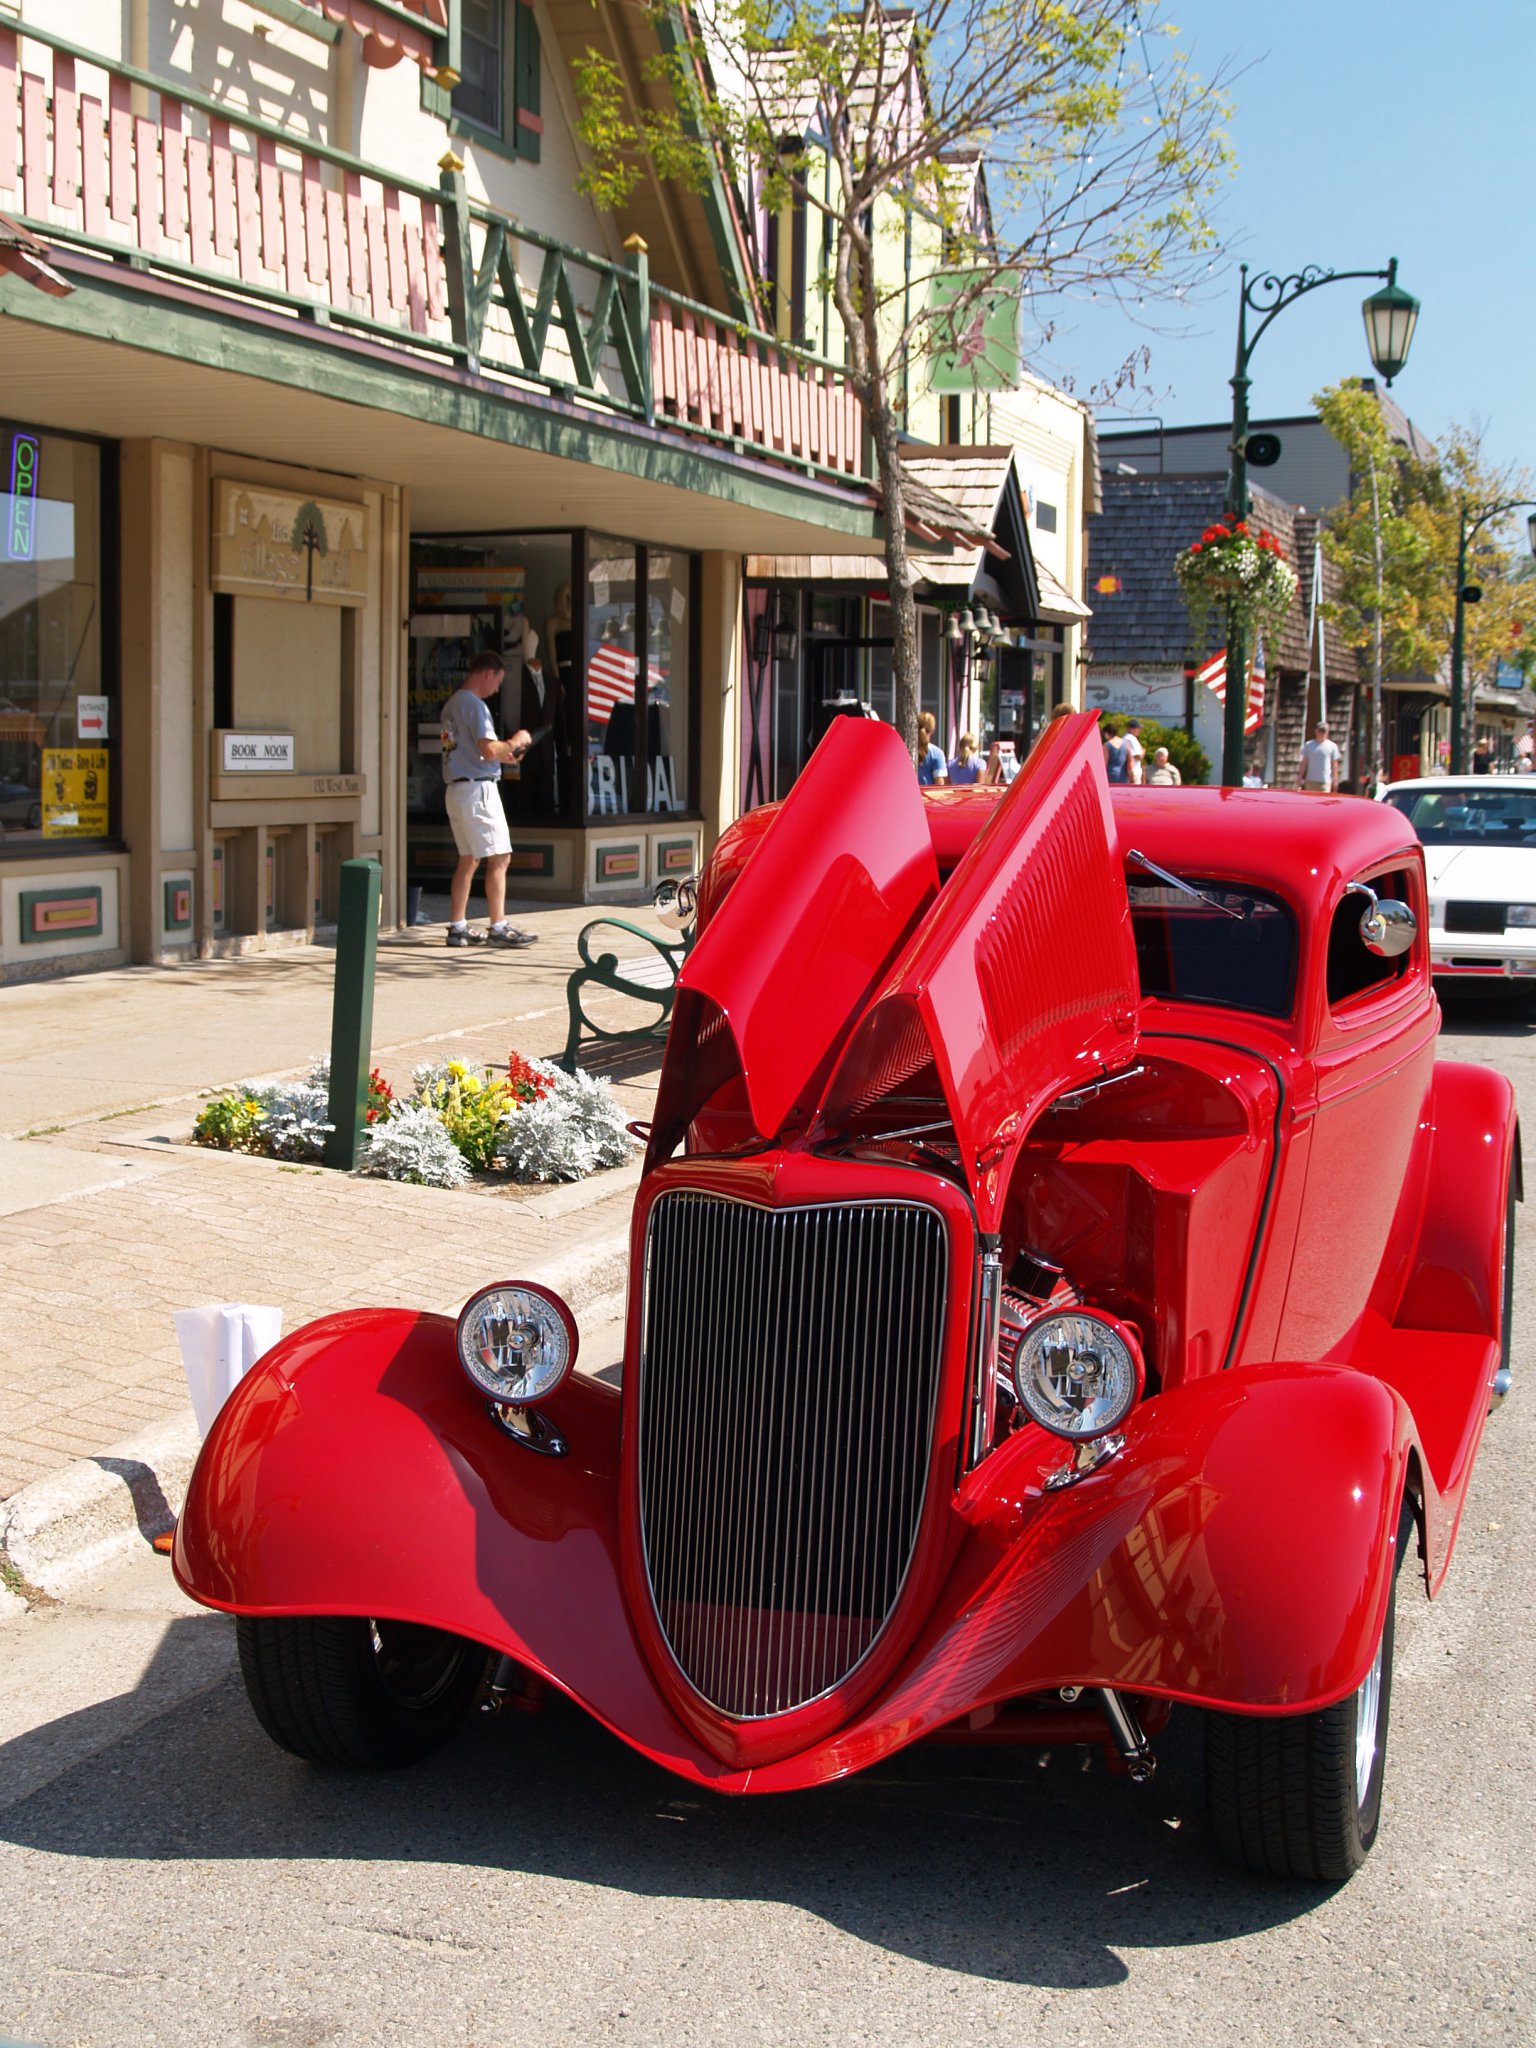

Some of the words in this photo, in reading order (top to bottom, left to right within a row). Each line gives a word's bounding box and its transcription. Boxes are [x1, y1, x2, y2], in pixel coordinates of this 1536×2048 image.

[14, 442, 35, 554] OPEN
[239, 540, 299, 593] village
[231, 744, 257, 757] BOOK
[264, 745, 289, 757] NOOK
